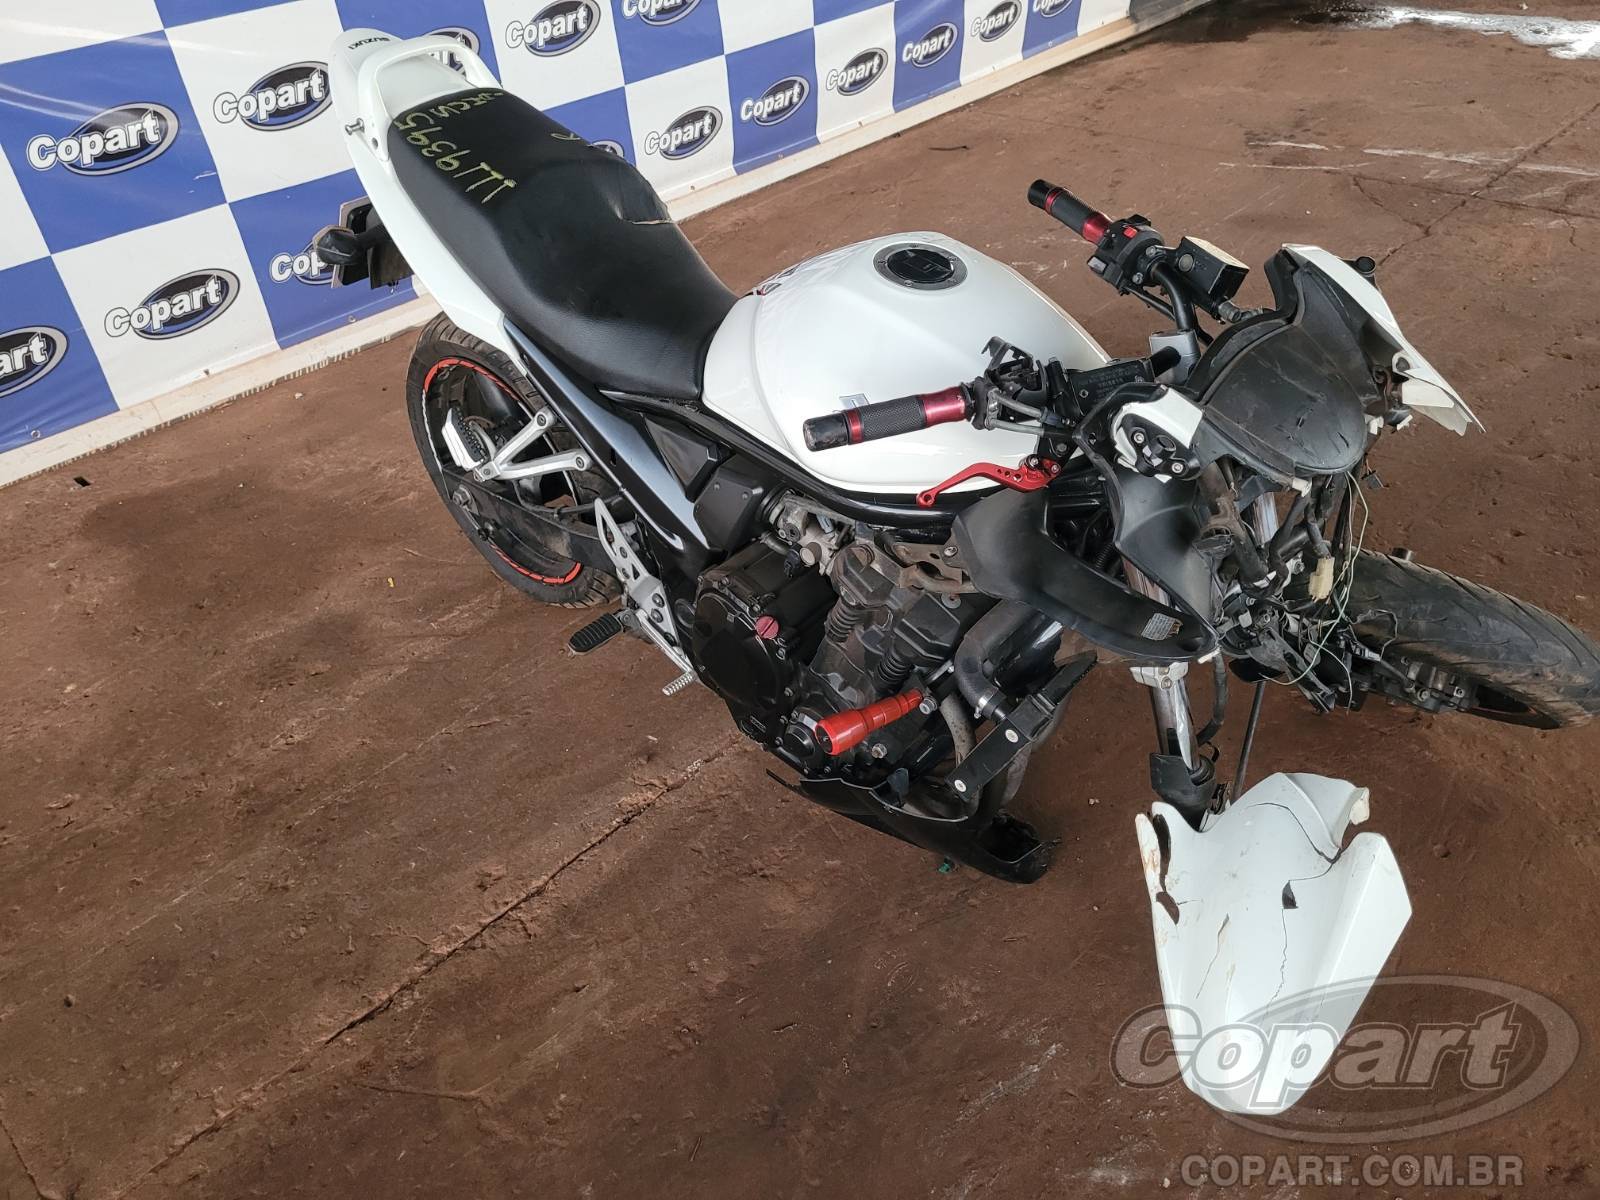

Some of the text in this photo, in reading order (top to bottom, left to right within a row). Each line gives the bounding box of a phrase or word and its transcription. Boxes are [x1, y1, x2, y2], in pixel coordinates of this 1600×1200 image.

[505, 3, 589, 48] Copart
[971, 3, 1017, 37] Copart
[348, 37, 391, 50] SUZUKI
[902, 25, 951, 63] Copart
[826, 49, 881, 91] Copart
[213, 69, 326, 124] Copart
[740, 76, 802, 121] Copart
[27, 108, 161, 171] Copart
[644, 108, 712, 155] Copart
[269, 251, 328, 283] Cop
[104, 274, 222, 338] Copart
[0, 331, 48, 378] art
